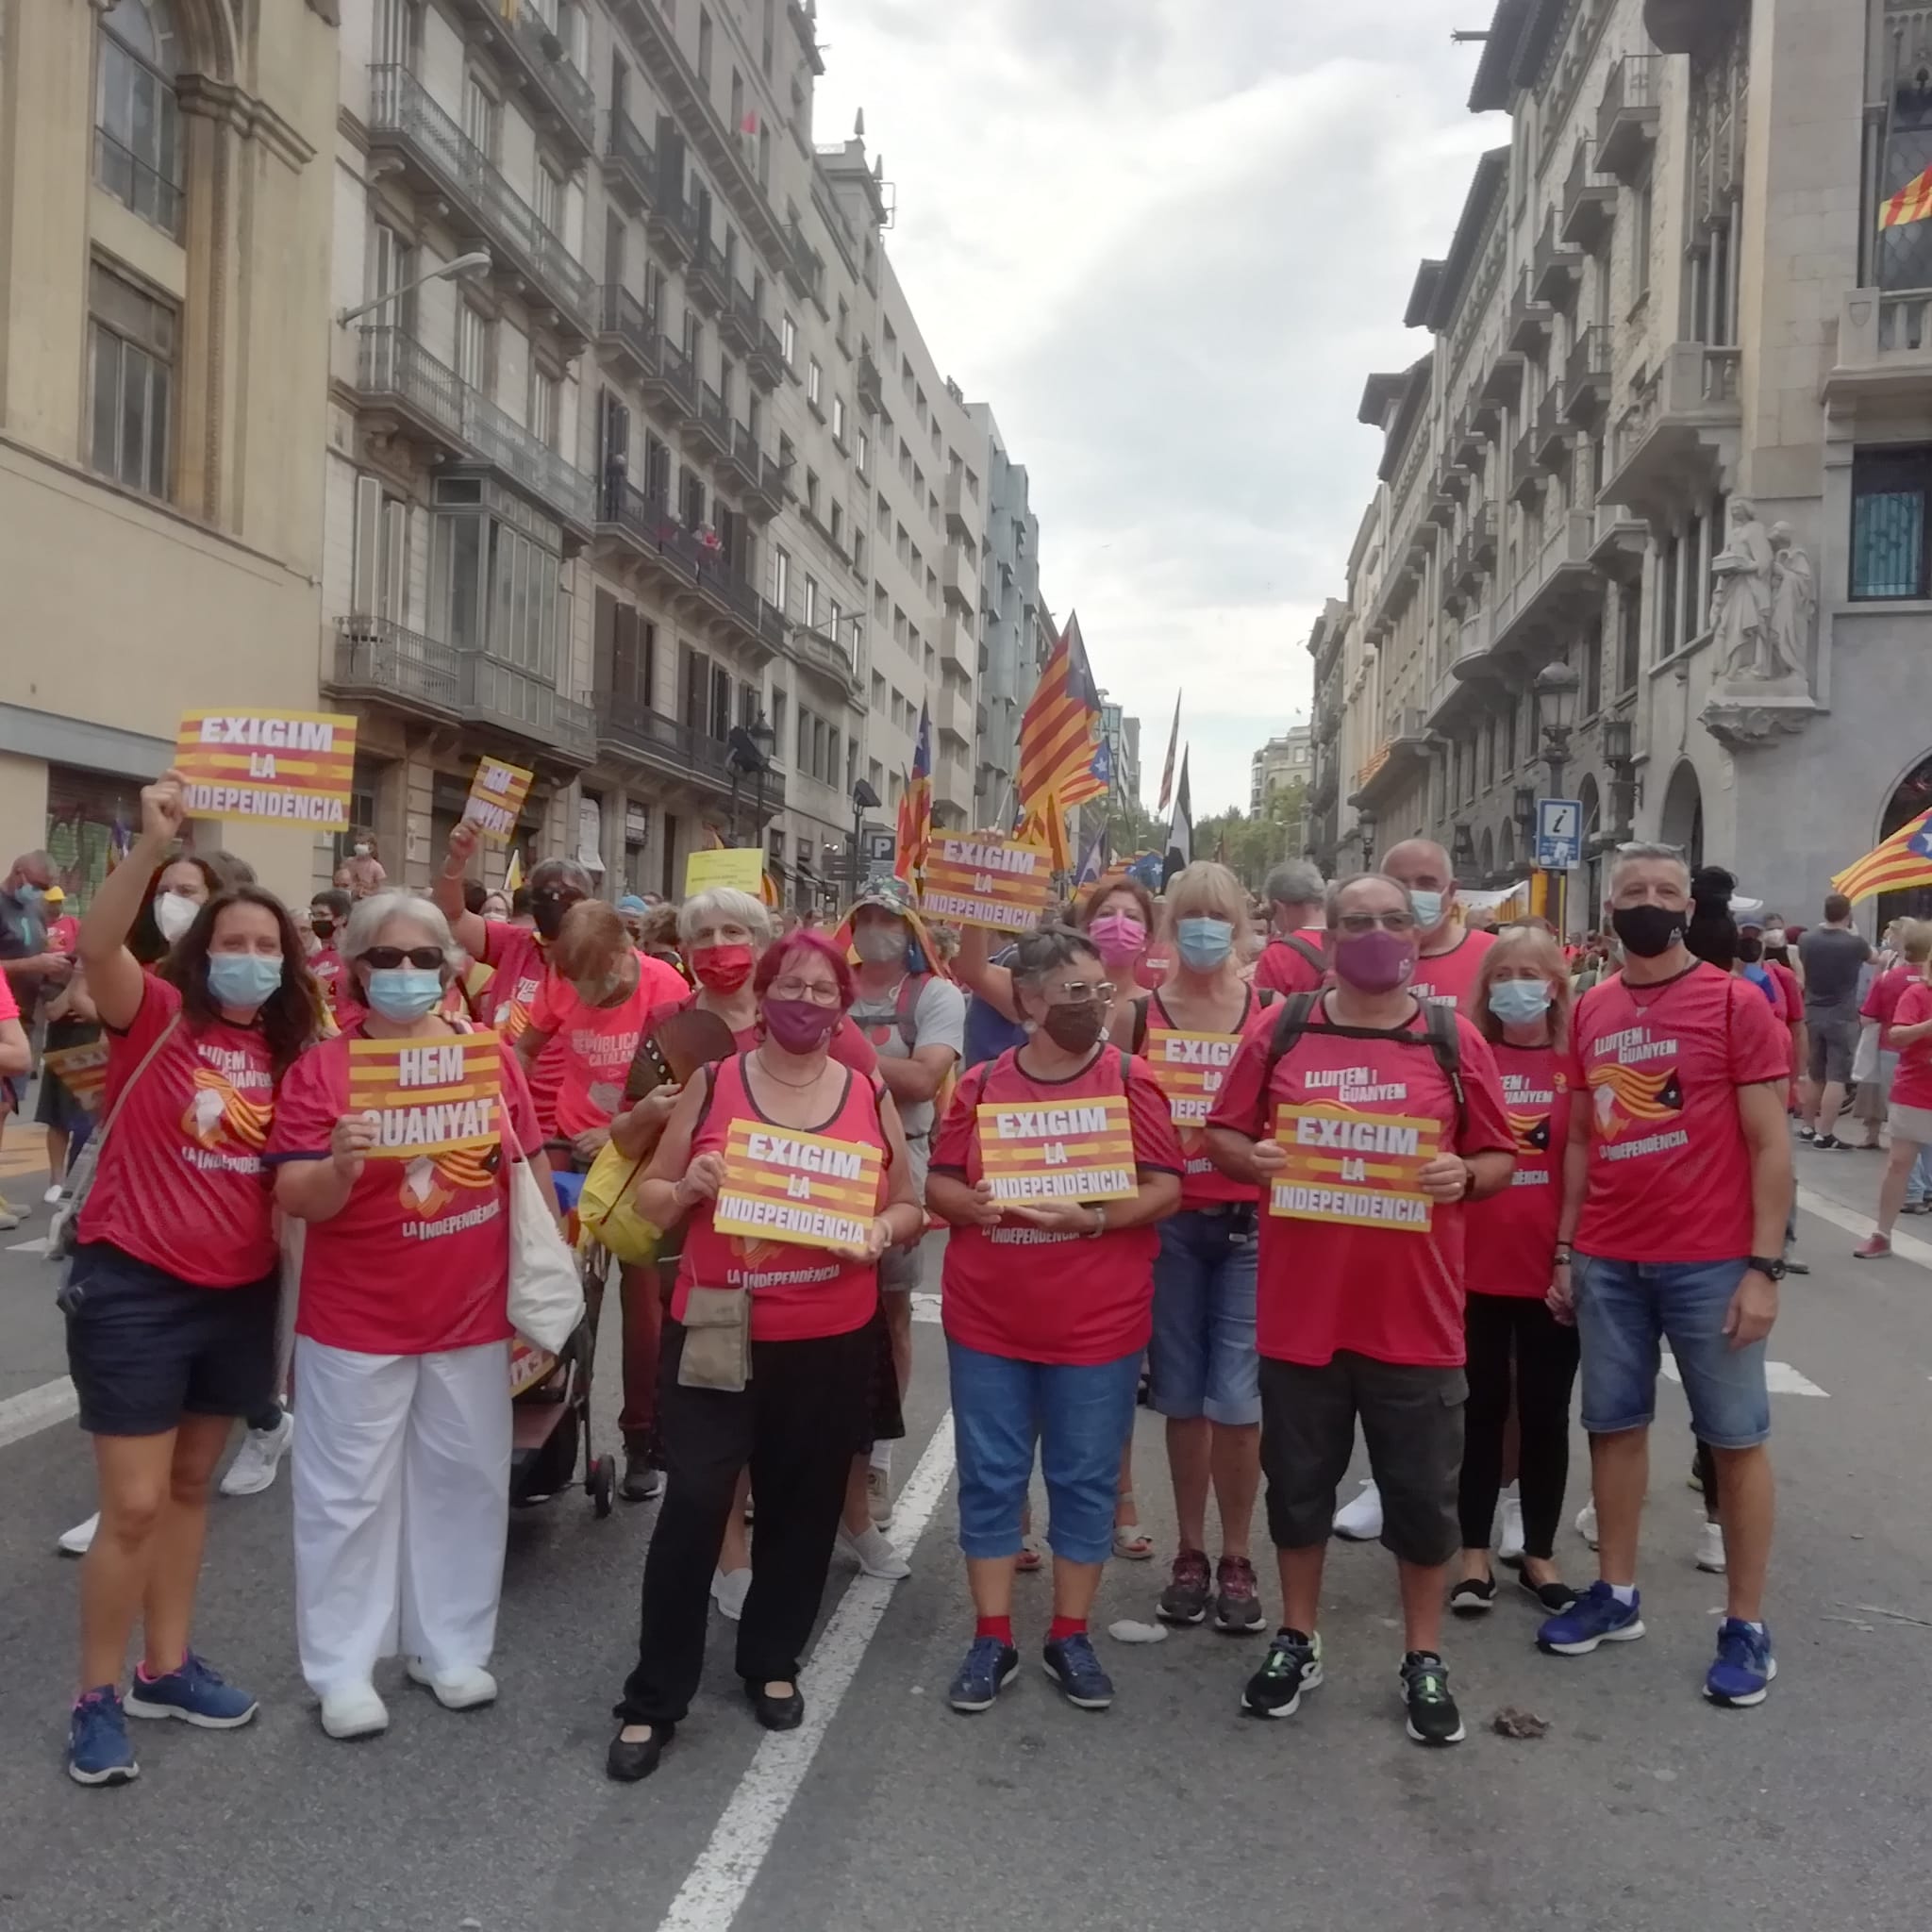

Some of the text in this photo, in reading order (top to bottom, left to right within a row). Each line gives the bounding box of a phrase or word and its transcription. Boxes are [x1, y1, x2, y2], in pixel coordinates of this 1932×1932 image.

[200, 716, 333, 752] EXIGIM
[249, 752, 276, 778] LA
[183, 784, 344, 823] NDEPENDÈNCIA
[874, 838, 891, 858] P
[943, 839, 1036, 874] EXIGIM
[974, 872, 993, 893] LA
[399, 1043, 464, 1086] HEM
[1305, 1067, 1368, 1089] LLUITEM
[1339, 1083, 1407, 1103] GUANYEM
[997, 1107, 1108, 1139] EXIGIM
[1297, 1116, 1420, 1156] EXIGIM
[747, 1132, 862, 1180] EXIGIM
[1043, 1141, 1068, 1165] LA
[1341, 1156, 1365, 1181] LA
[787, 1173, 810, 1199] LA
[991, 1168, 1131, 1200] INDEPENDÈNCIA
[720, 1195, 865, 1243] INDEPENDÈNCIA
[1274, 1185, 1427, 1224] INDEPENDÈNCIA
[402, 1221, 418, 1238] LA
[726, 1268, 741, 1284] LA
